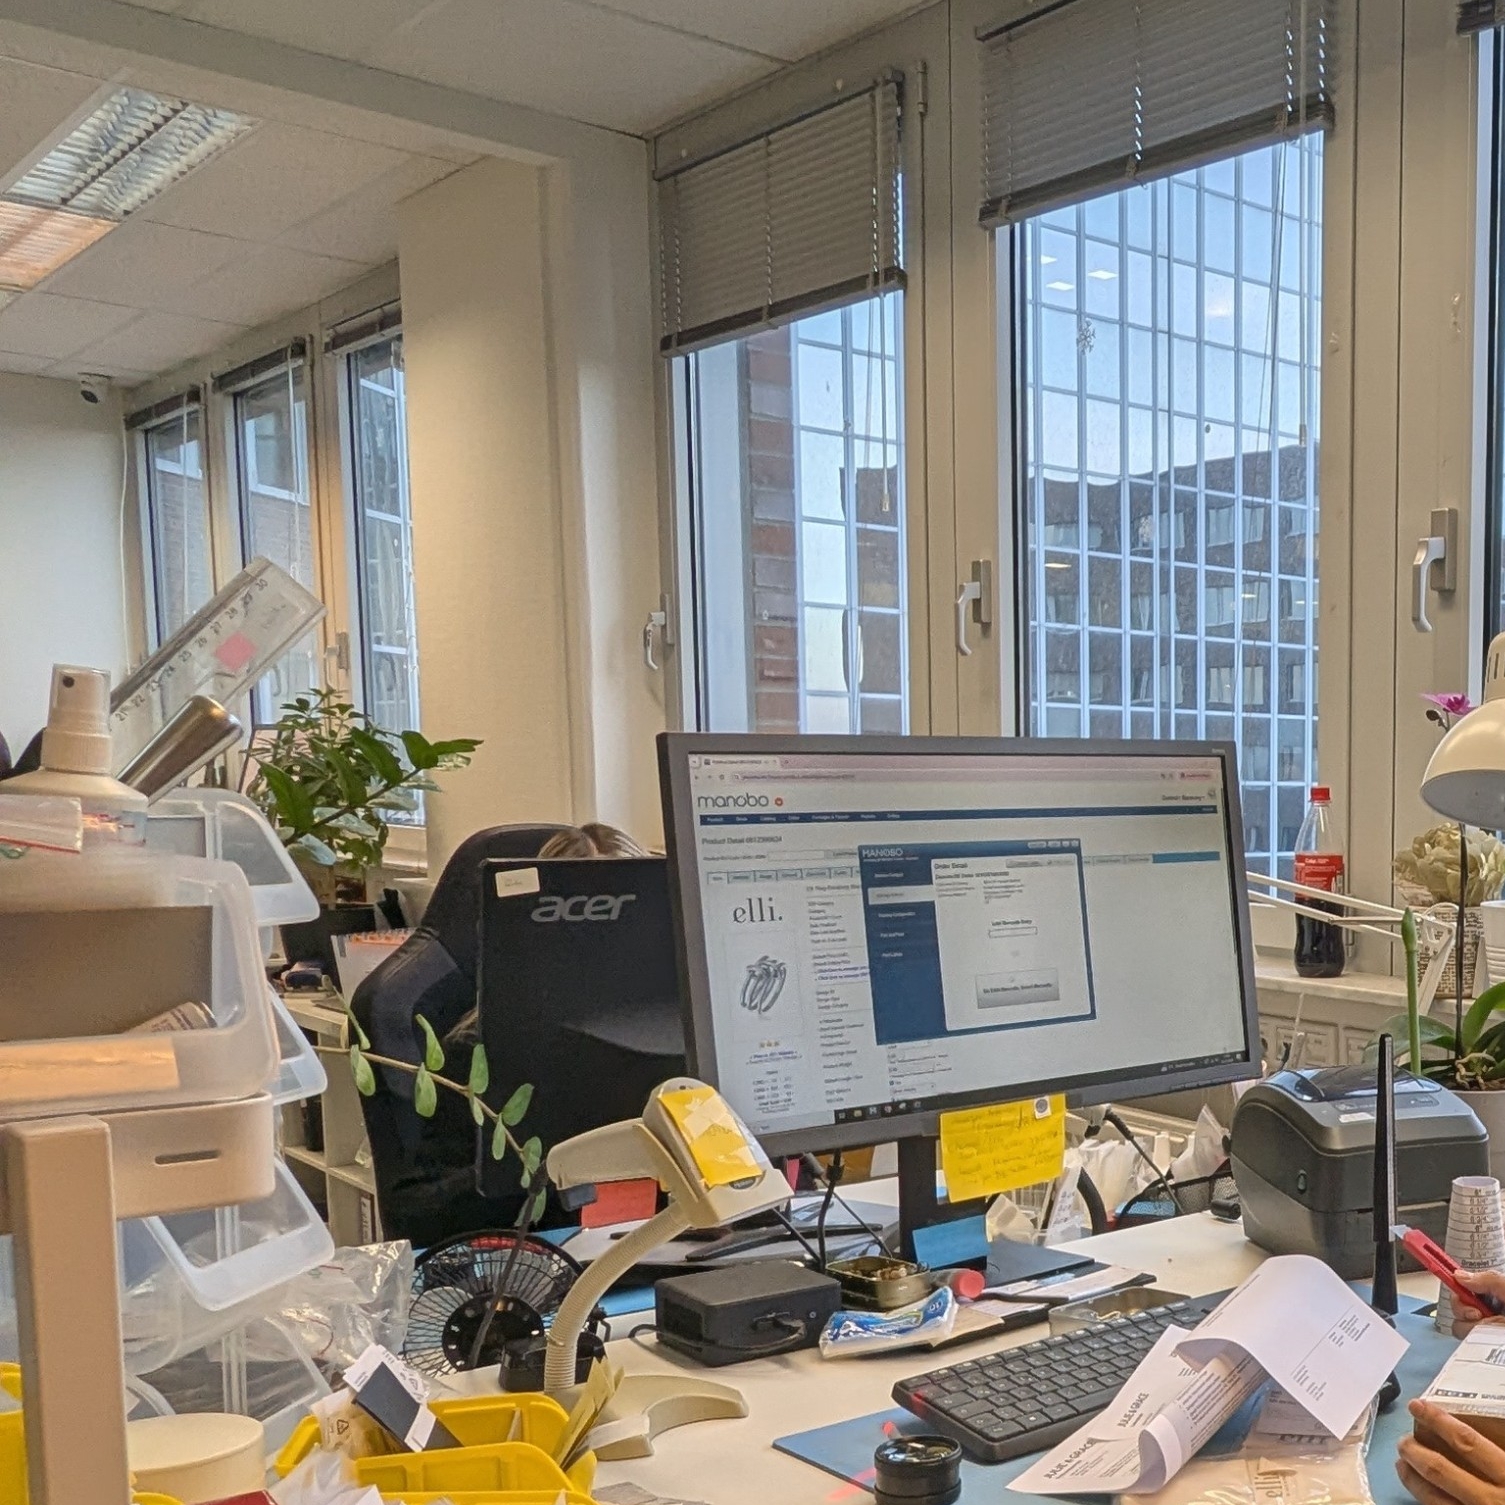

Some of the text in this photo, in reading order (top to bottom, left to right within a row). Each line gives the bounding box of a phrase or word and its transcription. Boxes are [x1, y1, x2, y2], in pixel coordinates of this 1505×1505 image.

[697, 792, 770, 808] manobo
[531, 894, 636, 923] acer
[733, 897, 783, 923] elli.
